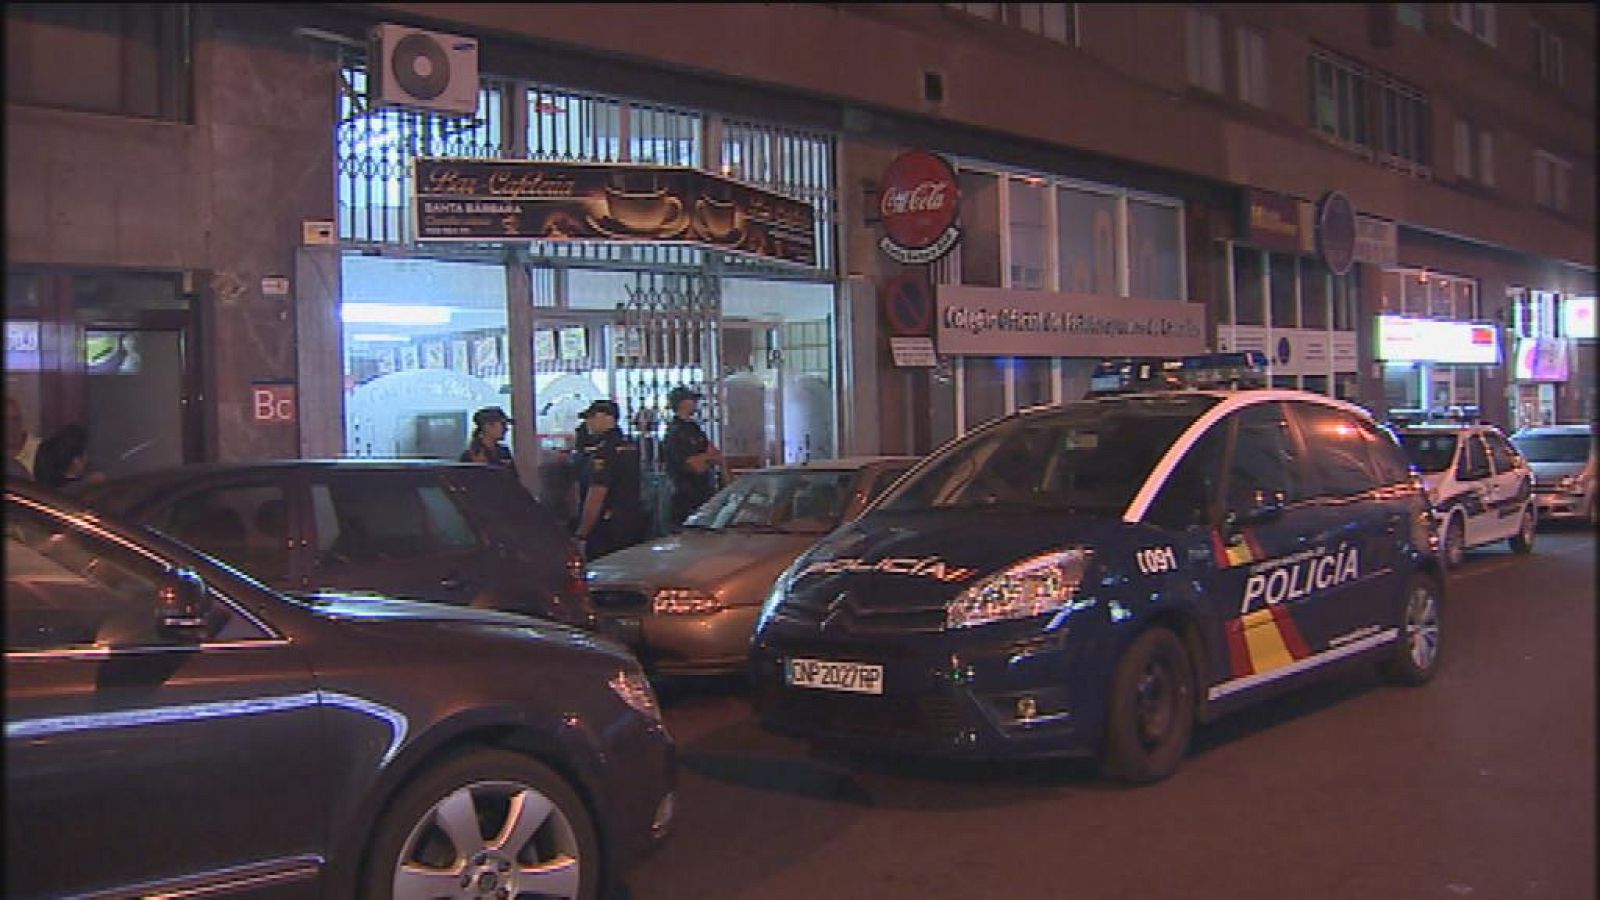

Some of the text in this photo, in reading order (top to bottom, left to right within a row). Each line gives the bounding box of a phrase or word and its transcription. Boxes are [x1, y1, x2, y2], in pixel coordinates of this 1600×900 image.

[424, 202, 464, 214] SANTA
[254, 390, 292, 420] Bc
[1240, 541, 1359, 614] POLICÍA
